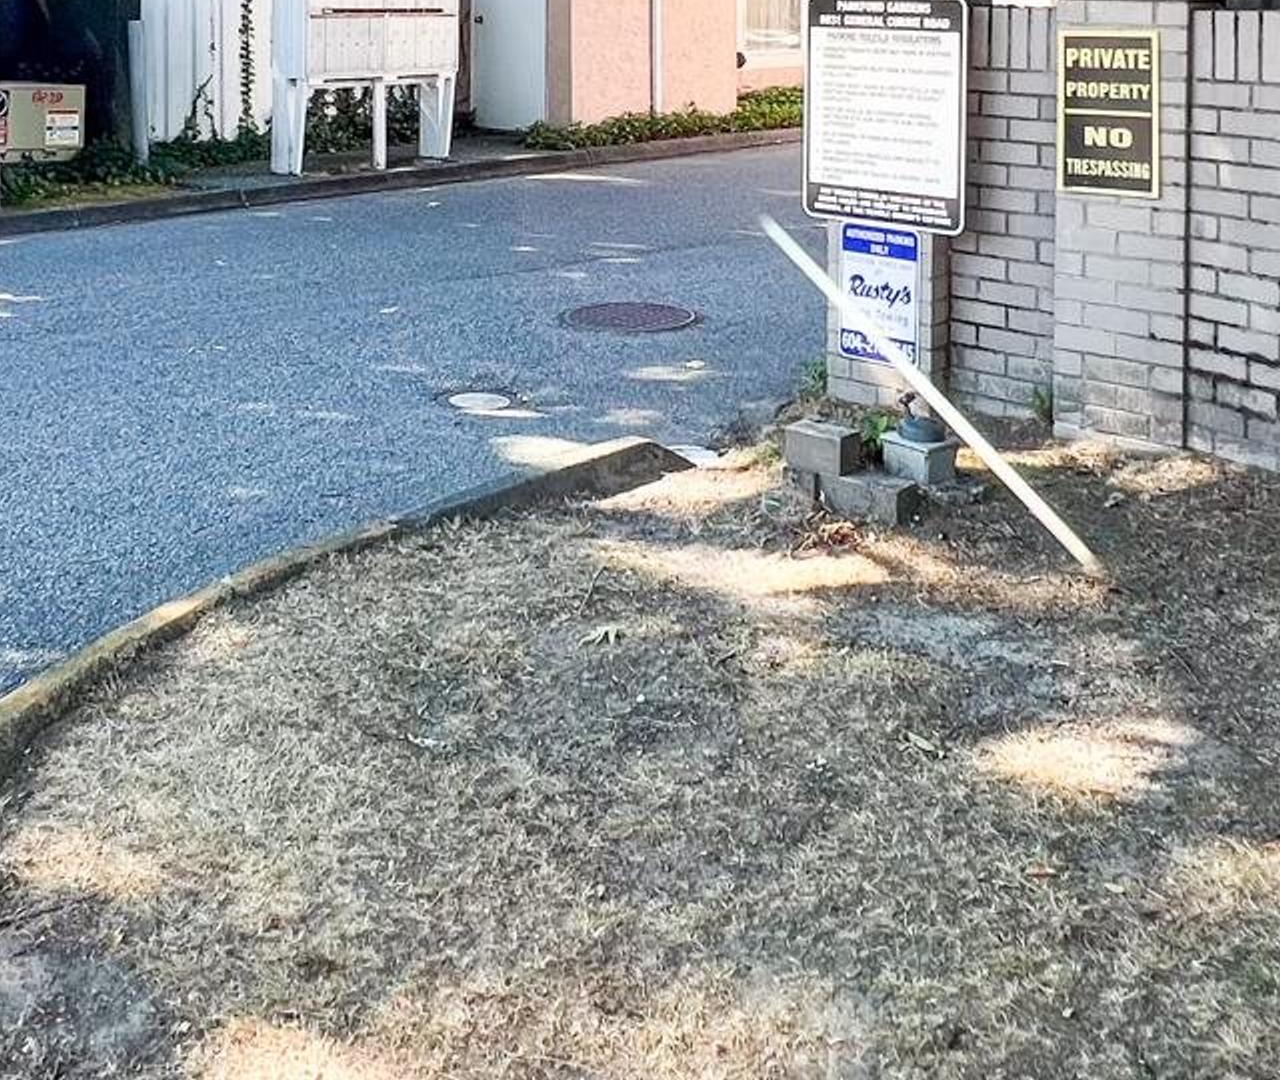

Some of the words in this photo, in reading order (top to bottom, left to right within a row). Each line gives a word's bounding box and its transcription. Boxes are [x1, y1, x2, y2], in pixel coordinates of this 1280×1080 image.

[1066, 47, 1151, 70] PRIVATE
[1066, 81, 1151, 100] PROPERTY
[1083, 125, 1134, 149] NO
[1066, 157, 1151, 180] TRESPASSING
[849, 274, 912, 308] Rusty's
